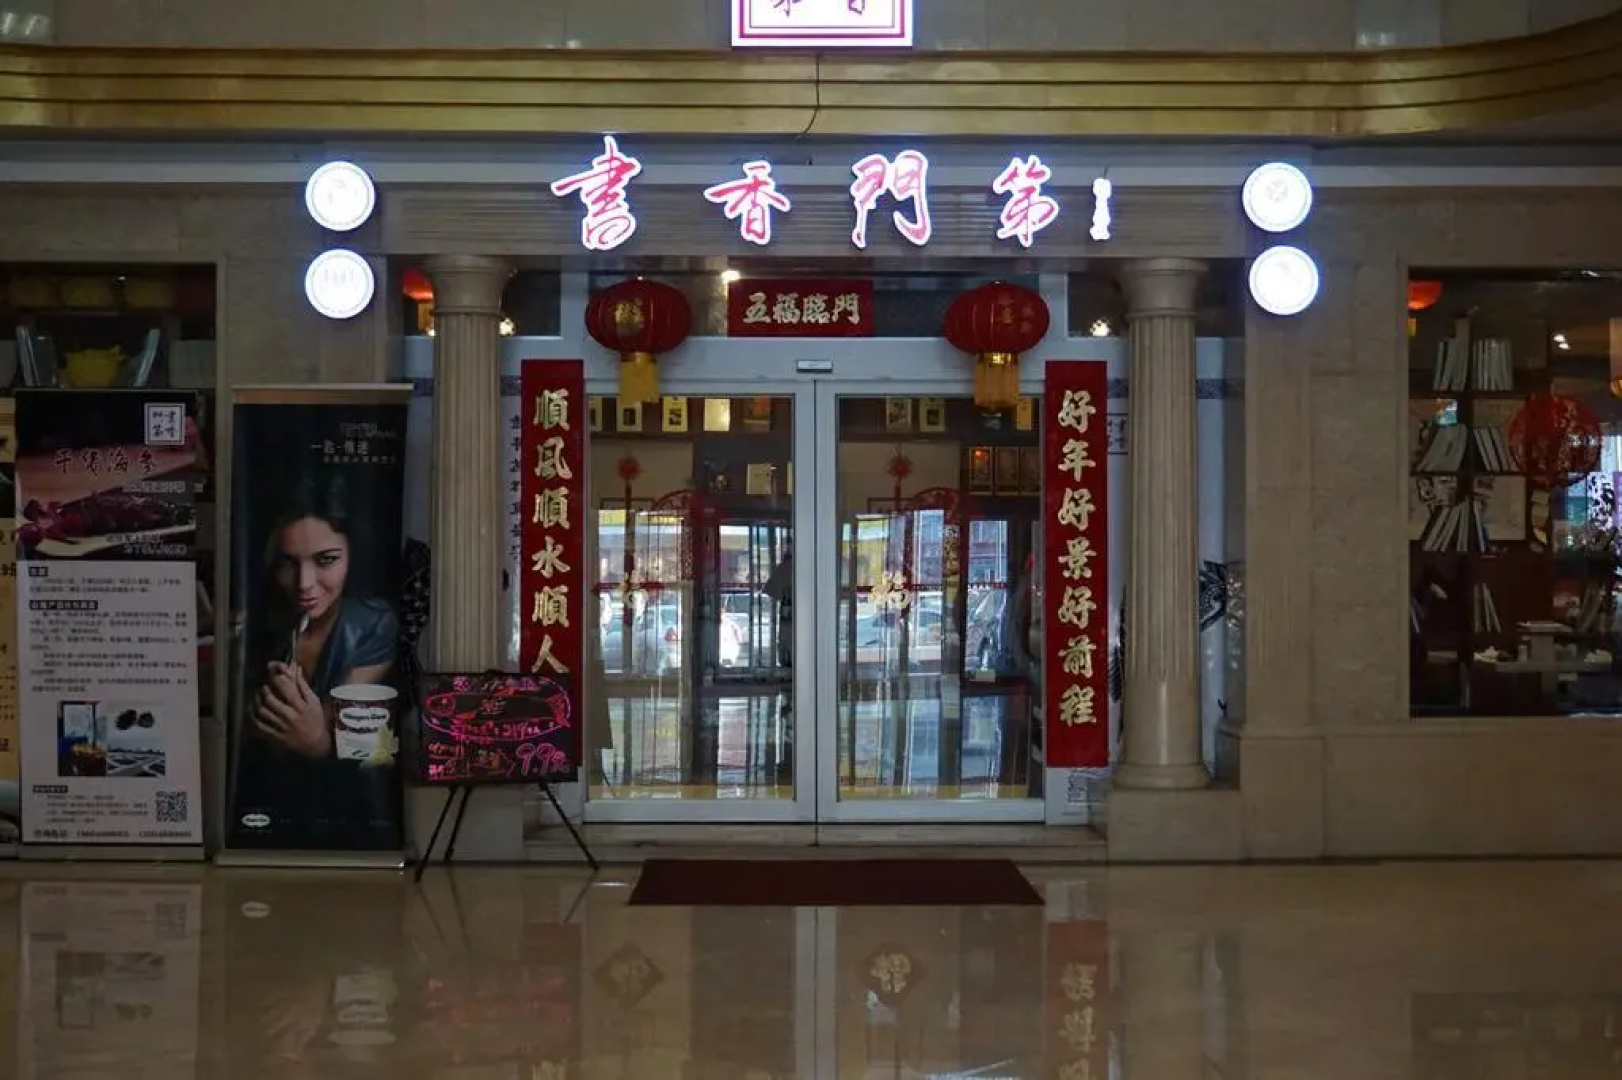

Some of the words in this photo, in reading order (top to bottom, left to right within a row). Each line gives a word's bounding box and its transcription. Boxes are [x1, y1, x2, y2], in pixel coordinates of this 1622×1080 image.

[551, 136, 1058, 250] 書香門第
[743, 292, 860, 325] 五福臨門
[1058, 389, 1098, 727] 好年好景好前程
